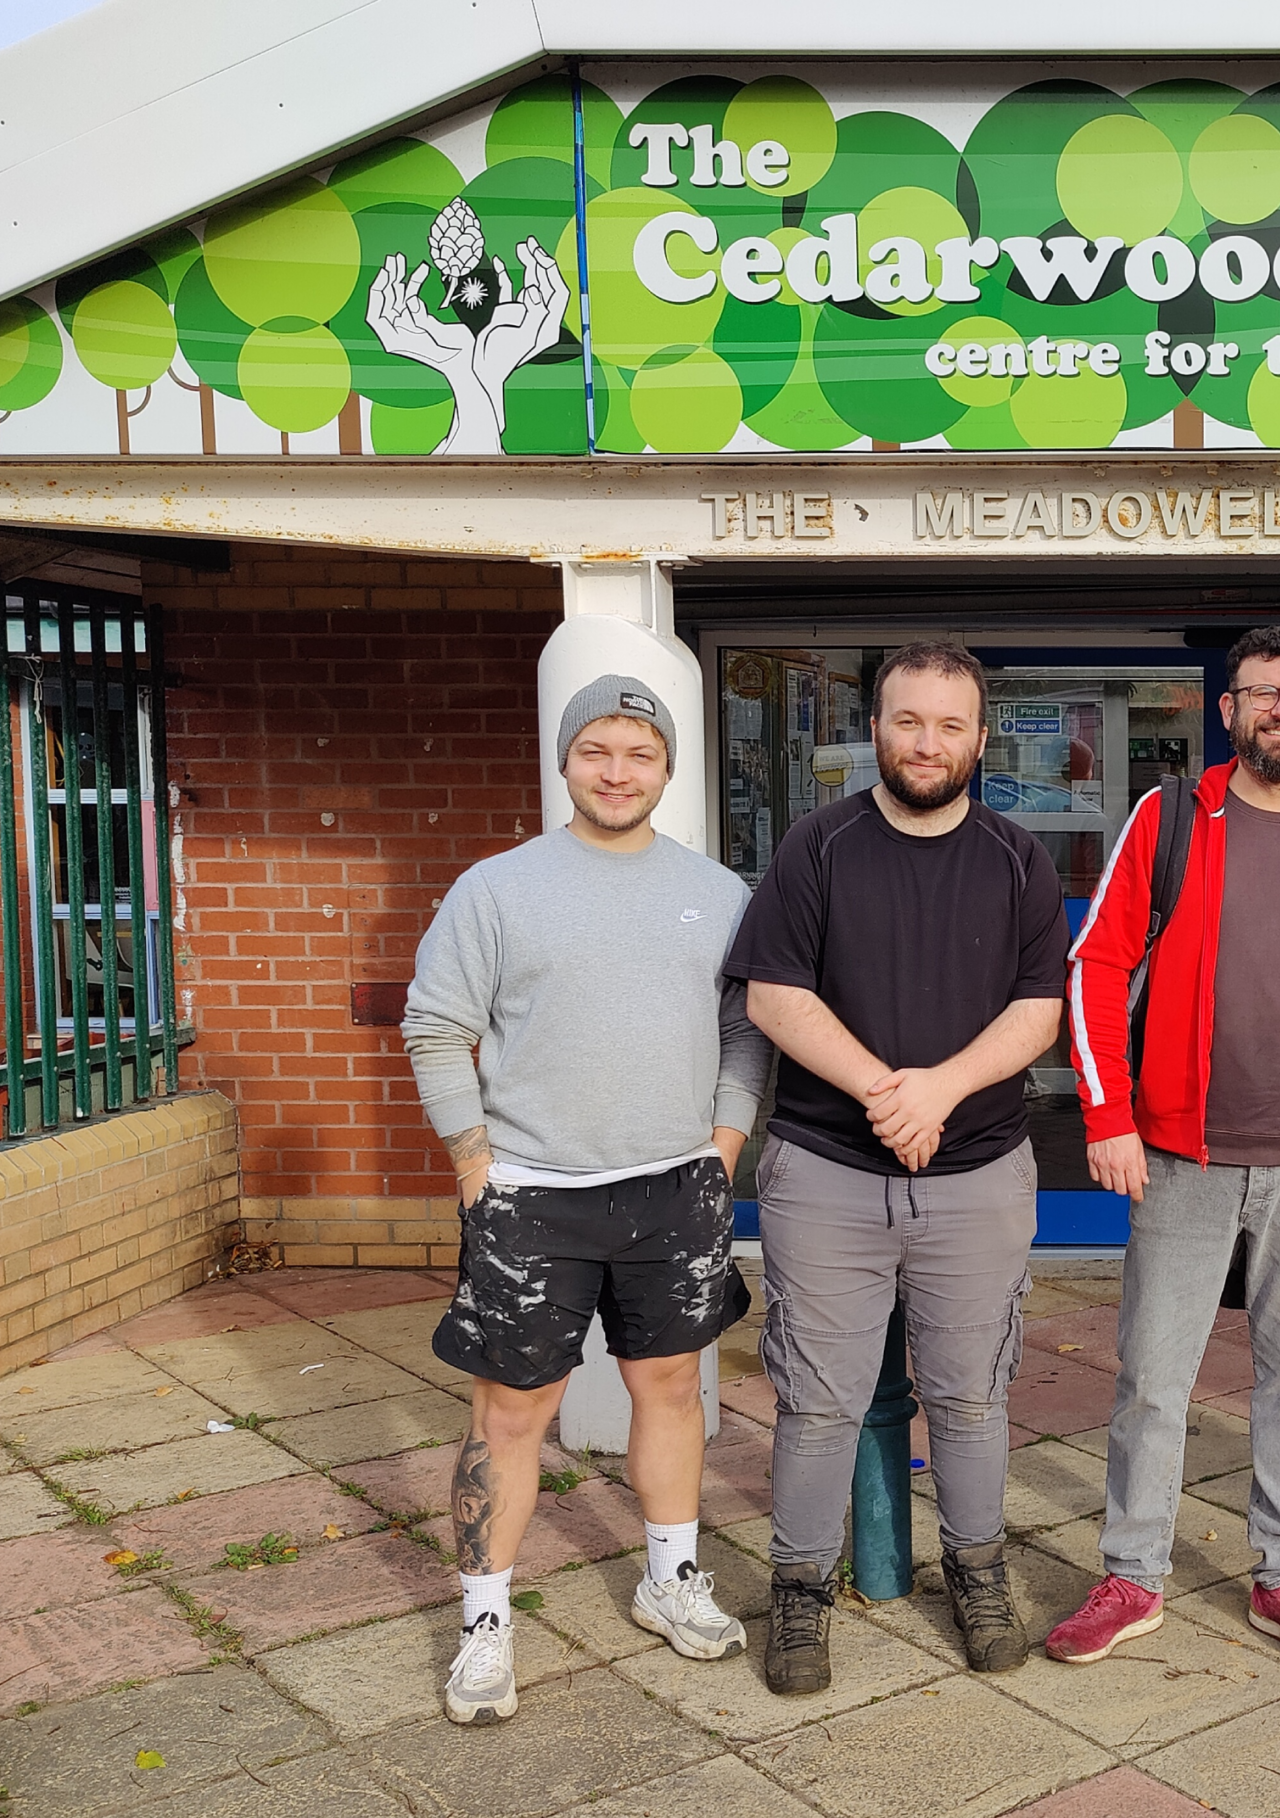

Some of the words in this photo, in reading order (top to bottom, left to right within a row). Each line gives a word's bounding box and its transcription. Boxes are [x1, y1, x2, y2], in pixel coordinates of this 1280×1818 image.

[629, 123, 790, 188] The
[925, 335, 1122, 377] centre
[1144, 331, 1240, 376] for
[700, 491, 833, 538] THE
[1020, 707, 1037, 715] Fire
[1038, 707, 1054, 715] exit
[1016, 722, 1037, 731] Keep
[1038, 722, 1059, 730] clear
[988, 781, 1015, 791] Keep
[989, 795, 1014, 803] clear
